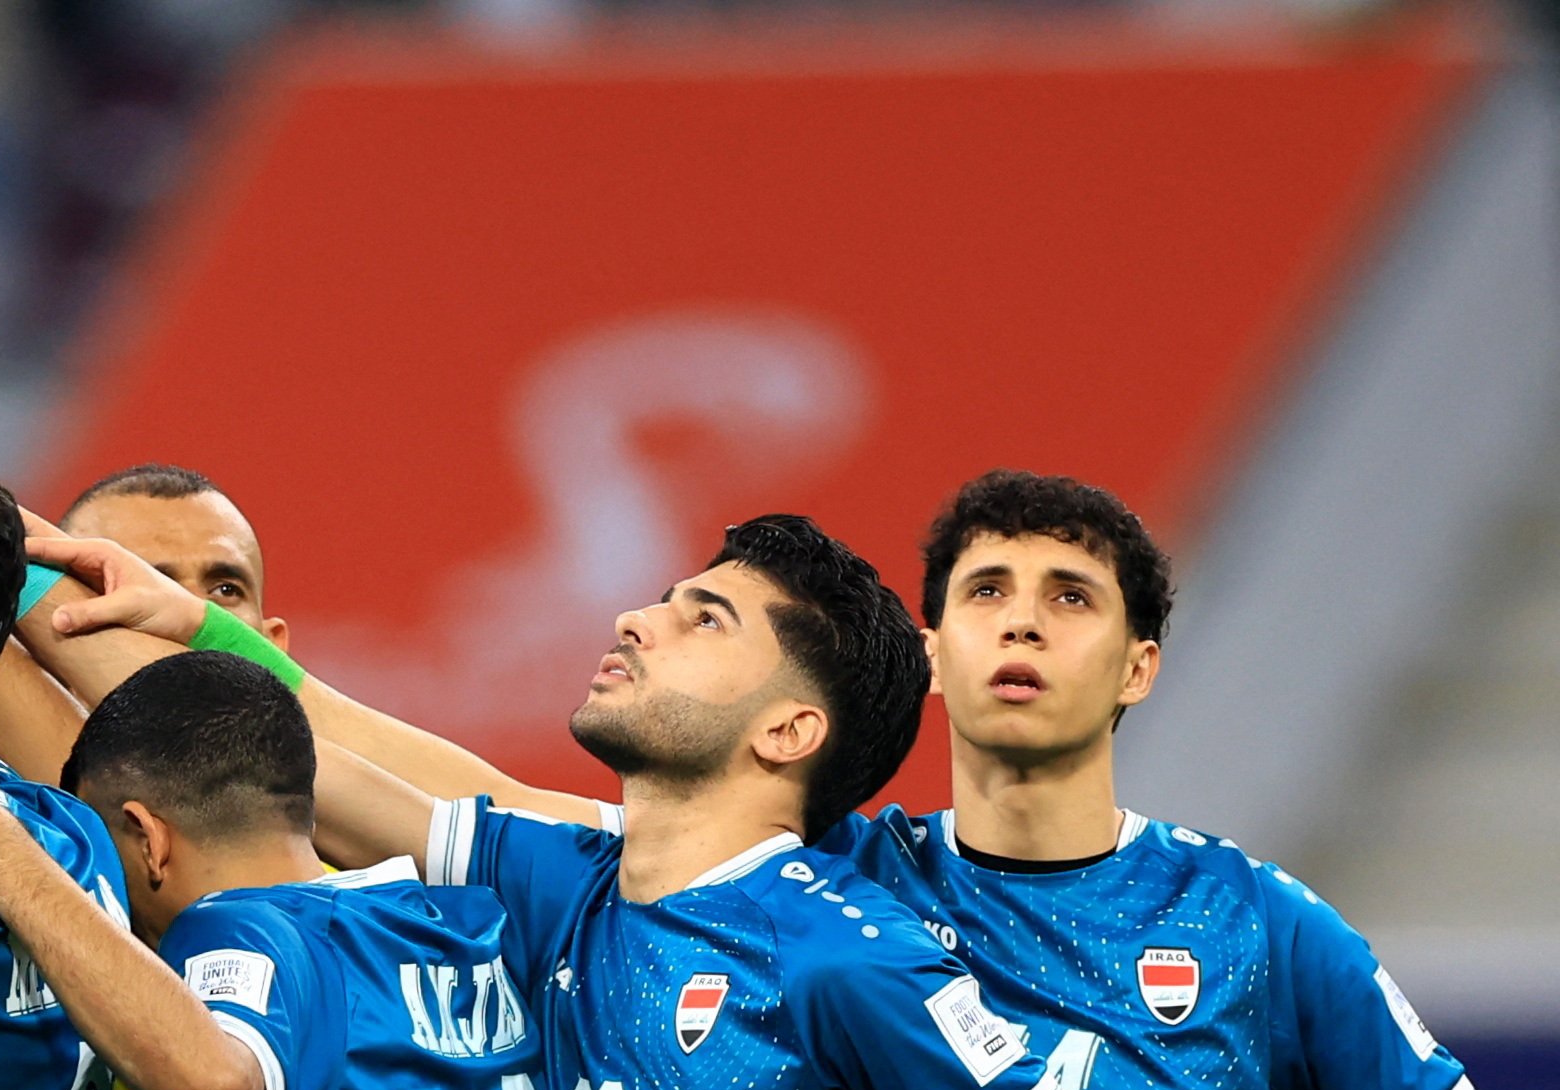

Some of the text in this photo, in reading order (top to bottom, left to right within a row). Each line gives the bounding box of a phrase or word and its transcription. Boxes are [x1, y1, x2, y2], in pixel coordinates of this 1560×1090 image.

[1149, 953, 1185, 963] IRAQ
[202, 966, 252, 982] UNITES
[694, 978, 722, 986] IRAQ
